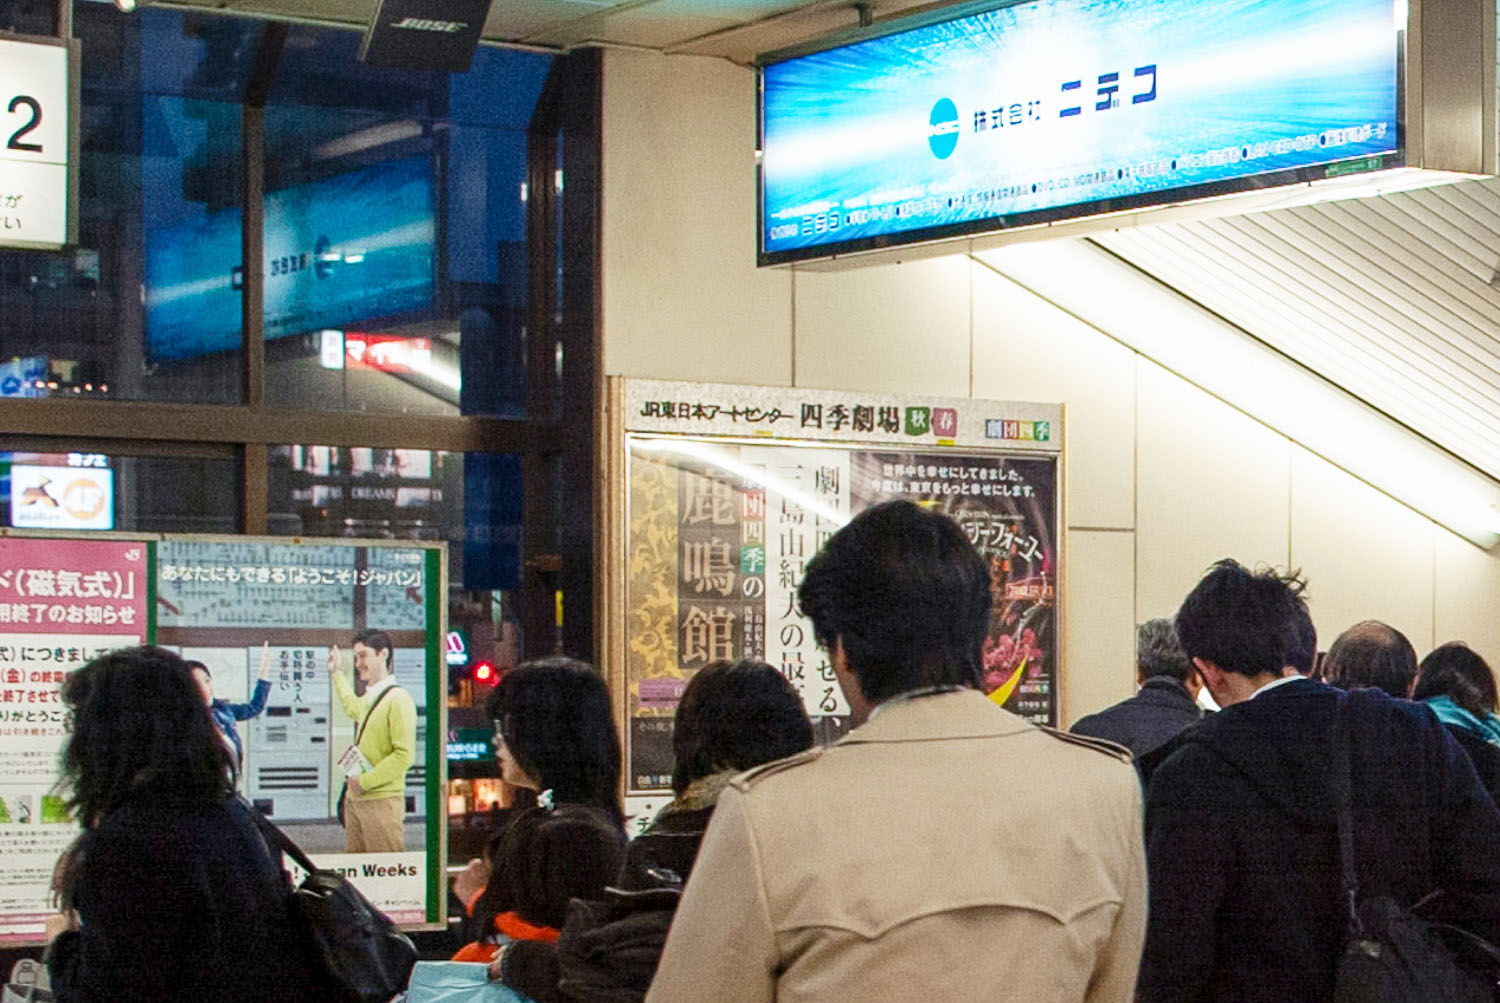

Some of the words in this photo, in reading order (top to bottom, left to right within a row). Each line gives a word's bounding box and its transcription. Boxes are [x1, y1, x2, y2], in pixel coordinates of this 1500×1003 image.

[391, 18, 467, 32] BOSE
[1059, 64, 1157, 118] ニデコ
[7, 95, 43, 152] 2
[640, 401, 794, 423] JR東日本アートセンター
[800, 403, 900, 433] 四季劇場
[0, 689, 62, 704] 終了させて
[362, 863, 418, 878] Weeks
